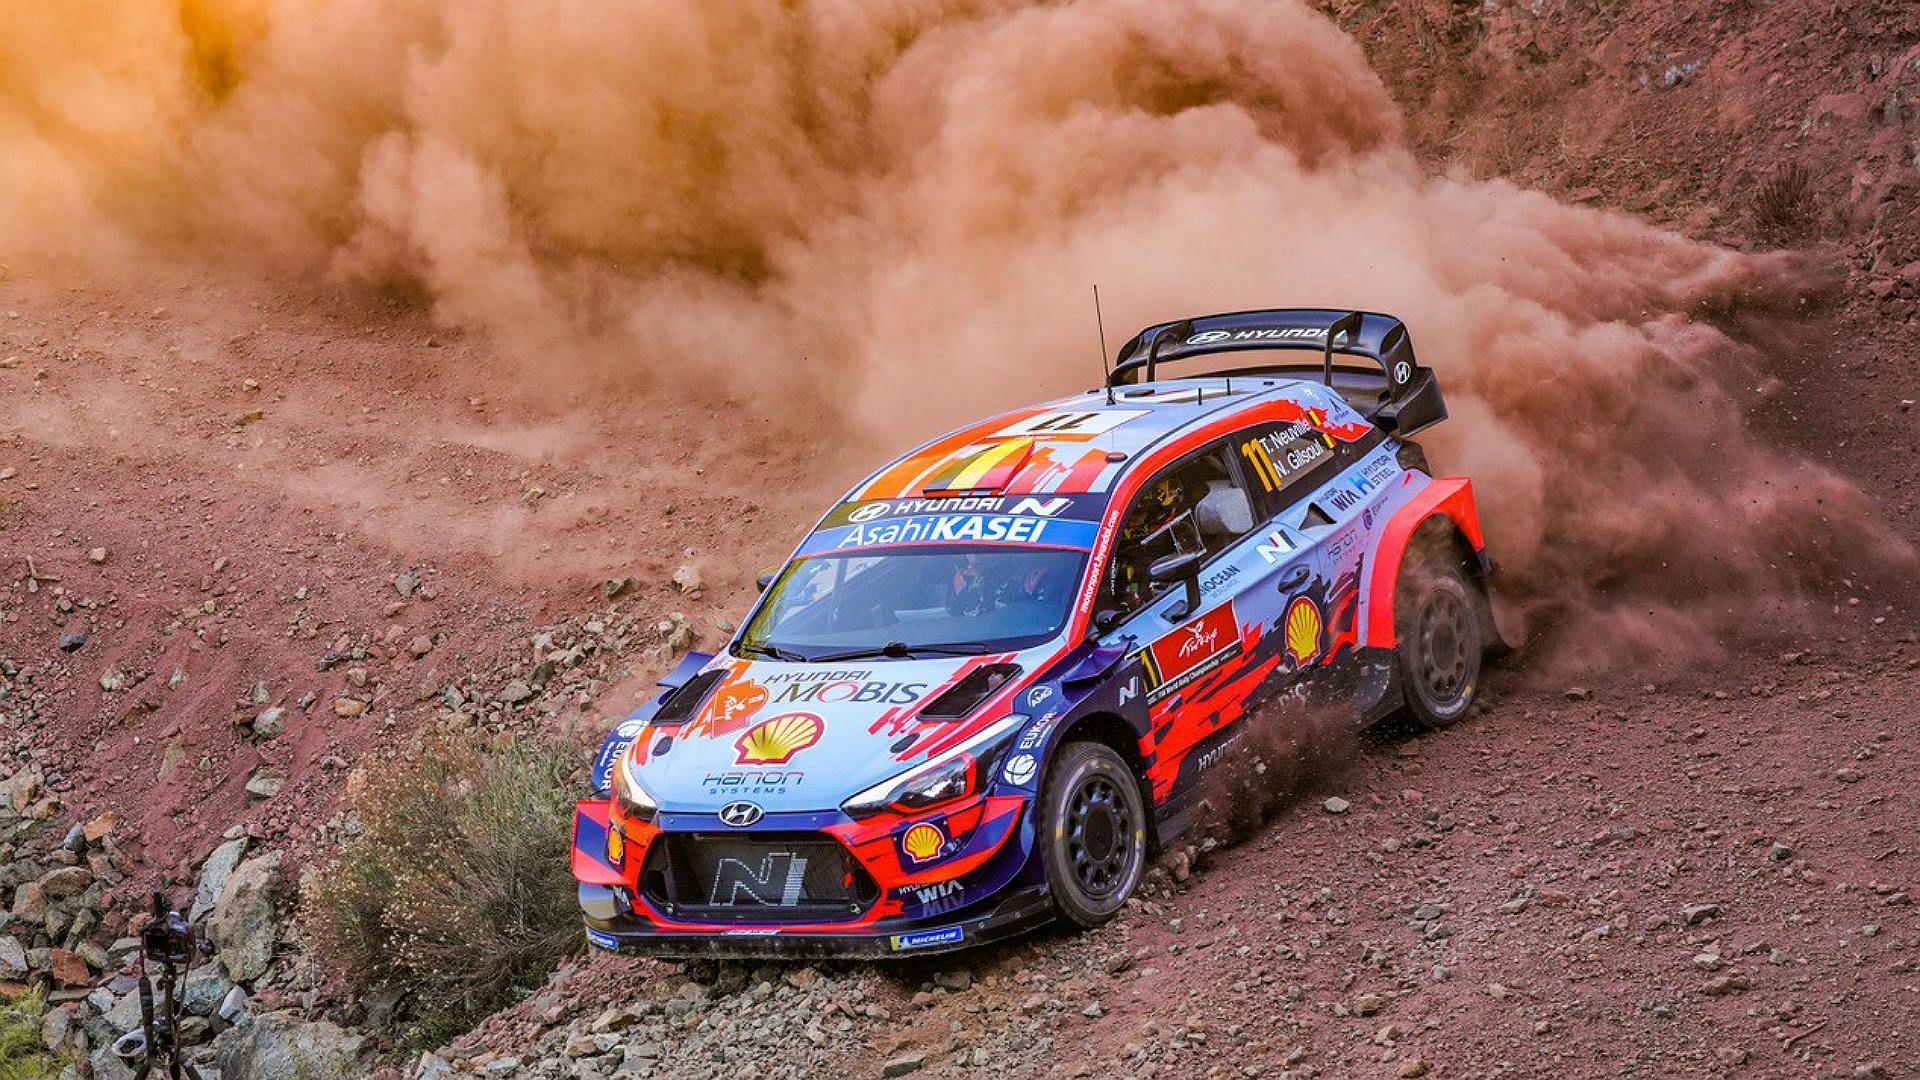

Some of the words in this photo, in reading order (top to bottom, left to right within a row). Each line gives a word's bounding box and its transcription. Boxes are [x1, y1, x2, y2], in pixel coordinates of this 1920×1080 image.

[1233, 328, 1346, 340] HYUNDAI
[1259, 437, 1274, 454] T.
[1268, 418, 1311, 449] Neuville
[1242, 438, 1282, 492] 11
[1273, 460, 1291, 478] N.
[1288, 439, 1324, 469] Gilsoul
[1371, 467, 1395, 486] STEEL
[893, 497, 1005, 515] HYUNDAI
[1081, 510, 1120, 613] motorsport.hyundai.com
[763, 670, 873, 684] HYUNDAI
[773, 682, 928, 704] MOBIS
[709, 787, 787, 795] SYSTEMS
[916, 879, 965, 904] WIA
